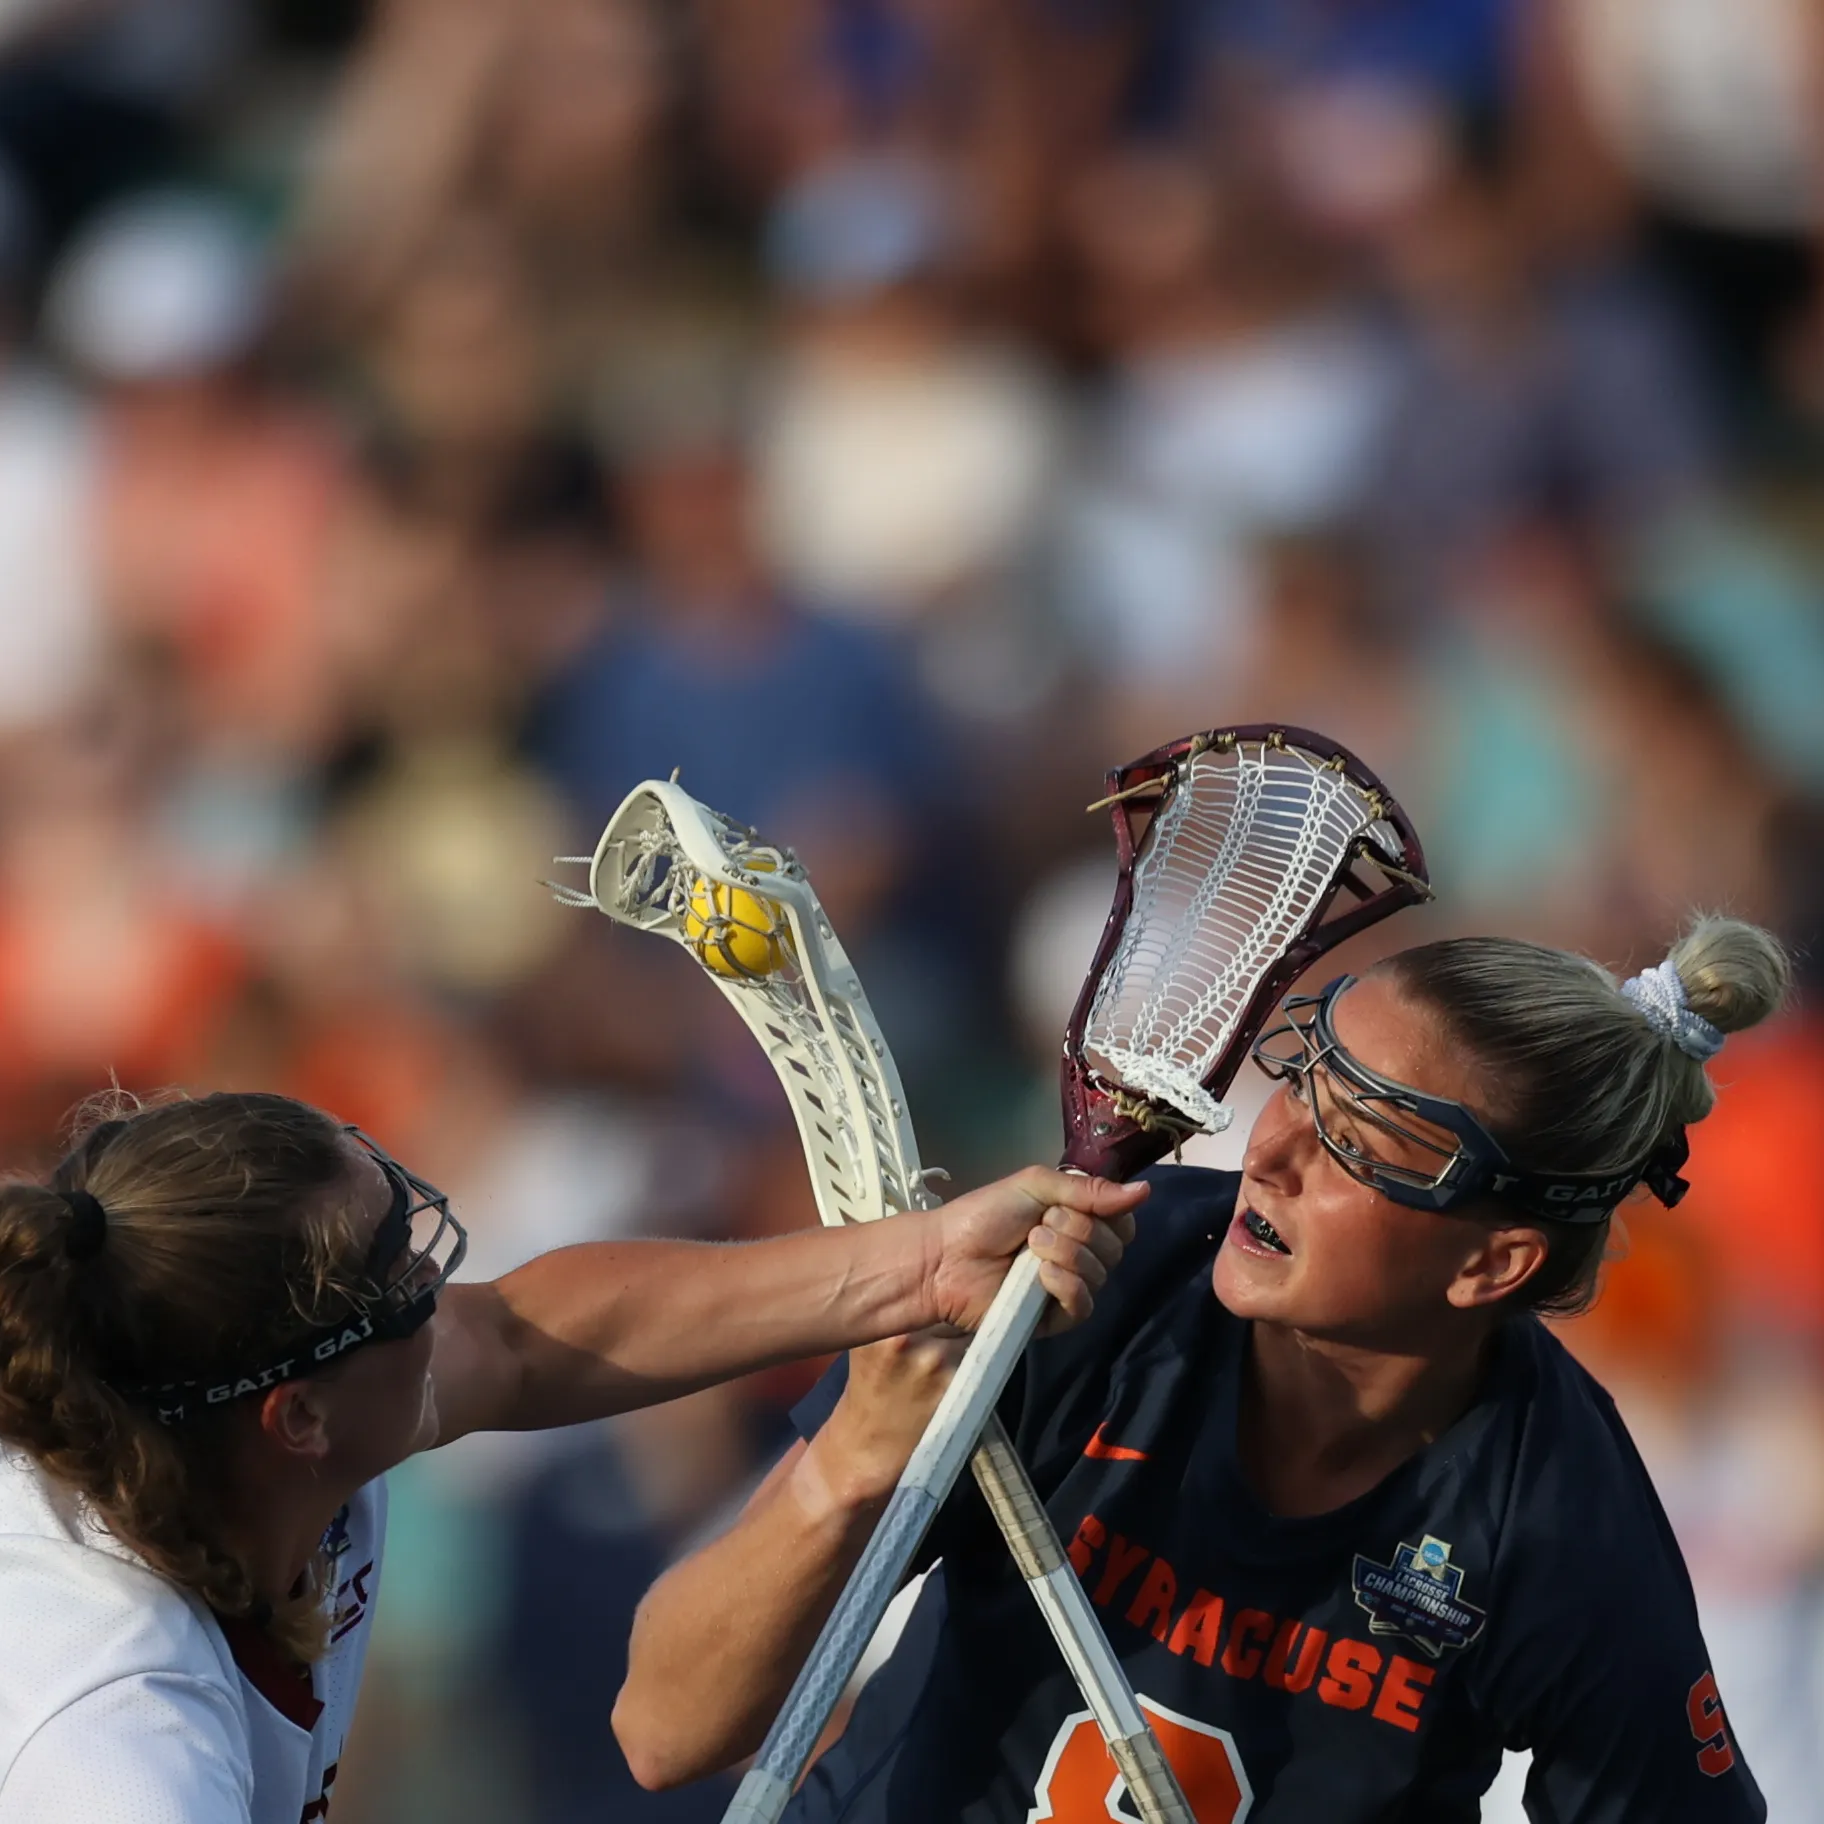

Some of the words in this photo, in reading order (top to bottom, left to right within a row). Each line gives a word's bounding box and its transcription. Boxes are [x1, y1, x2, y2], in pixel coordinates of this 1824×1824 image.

[1544, 1174, 1635, 1203] GAIT
[314, 1317, 375, 1361] GAI
[206, 1357, 296, 1404] GAIT
[1363, 1572, 1472, 1628] CHAMPIONSHIP
[1394, 1571, 1451, 1602] LACROSSE
[1067, 1513, 1438, 1733] SYRACUSE
